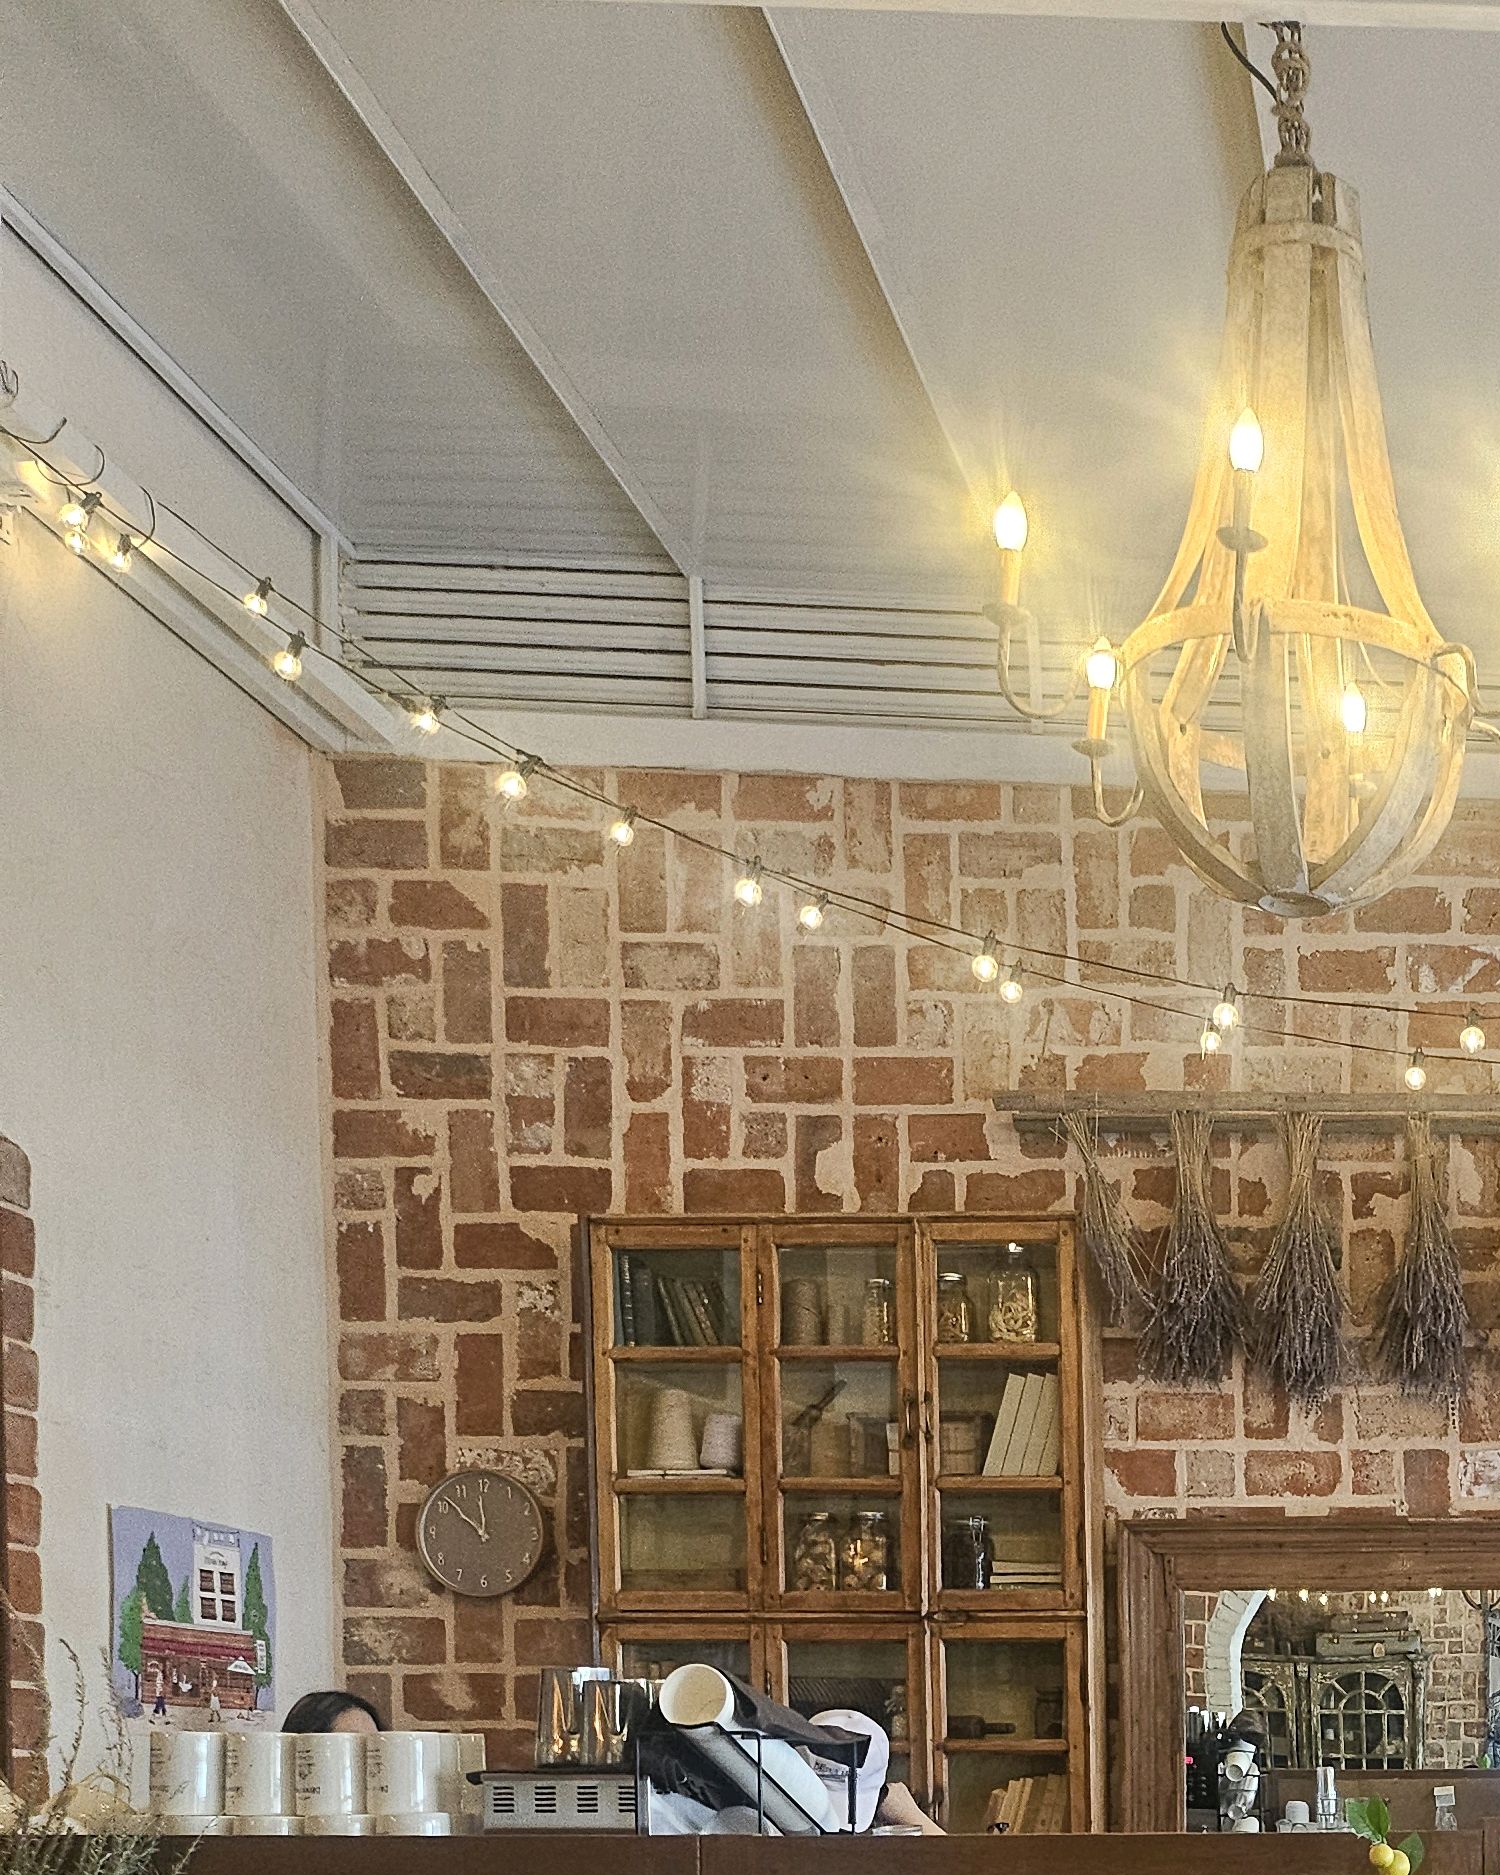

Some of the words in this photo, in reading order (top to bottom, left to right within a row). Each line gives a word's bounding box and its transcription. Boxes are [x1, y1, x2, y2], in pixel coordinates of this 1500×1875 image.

[456, 1485, 467, 1498] 11
[479, 1479, 490, 1493] 12
[507, 1486, 512, 1499] 1
[437, 1501, 449, 1514] 10
[524, 1502, 531, 1516] 2
[429, 1526, 436, 1539] 9
[531, 1527, 539, 1541] 3
[438, 1552, 445, 1565] 8
[456, 1569, 463, 1581] 7
[480, 1575, 488, 1588] 6
[505, 1570, 513, 1583] 5
